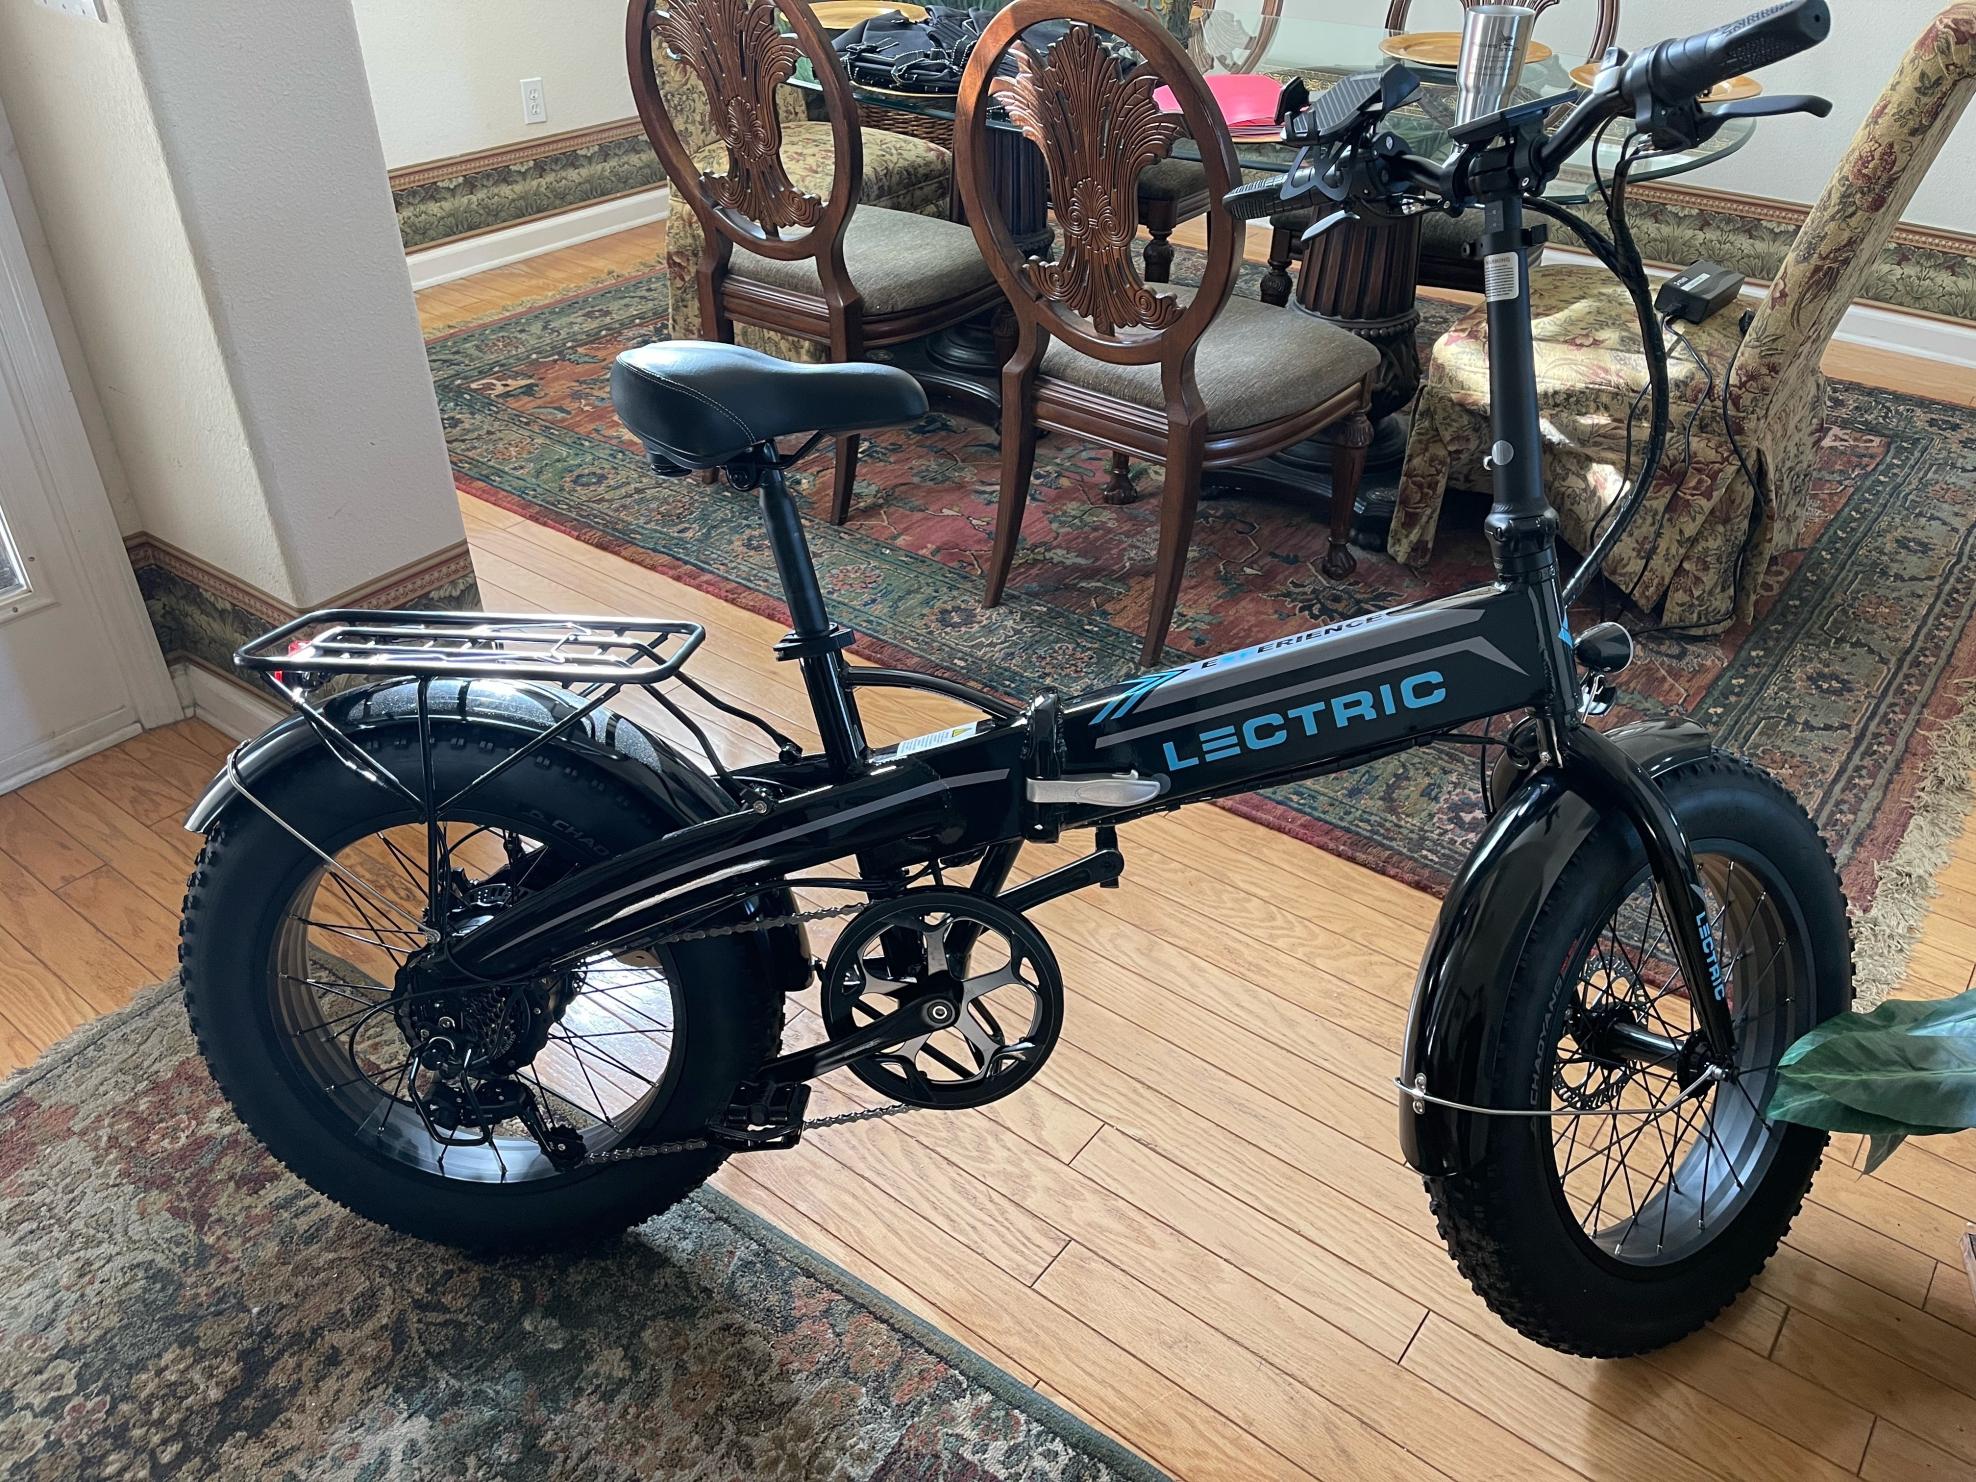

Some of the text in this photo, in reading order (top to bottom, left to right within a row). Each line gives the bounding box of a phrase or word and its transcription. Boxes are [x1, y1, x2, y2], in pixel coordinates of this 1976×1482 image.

[1201, 613, 1383, 669] EERIENCE
[1163, 671, 1446, 771] LECTRIC
[1696, 911, 1725, 1001] LECTRIC
[1530, 975, 1563, 1105] CHAOYANG
